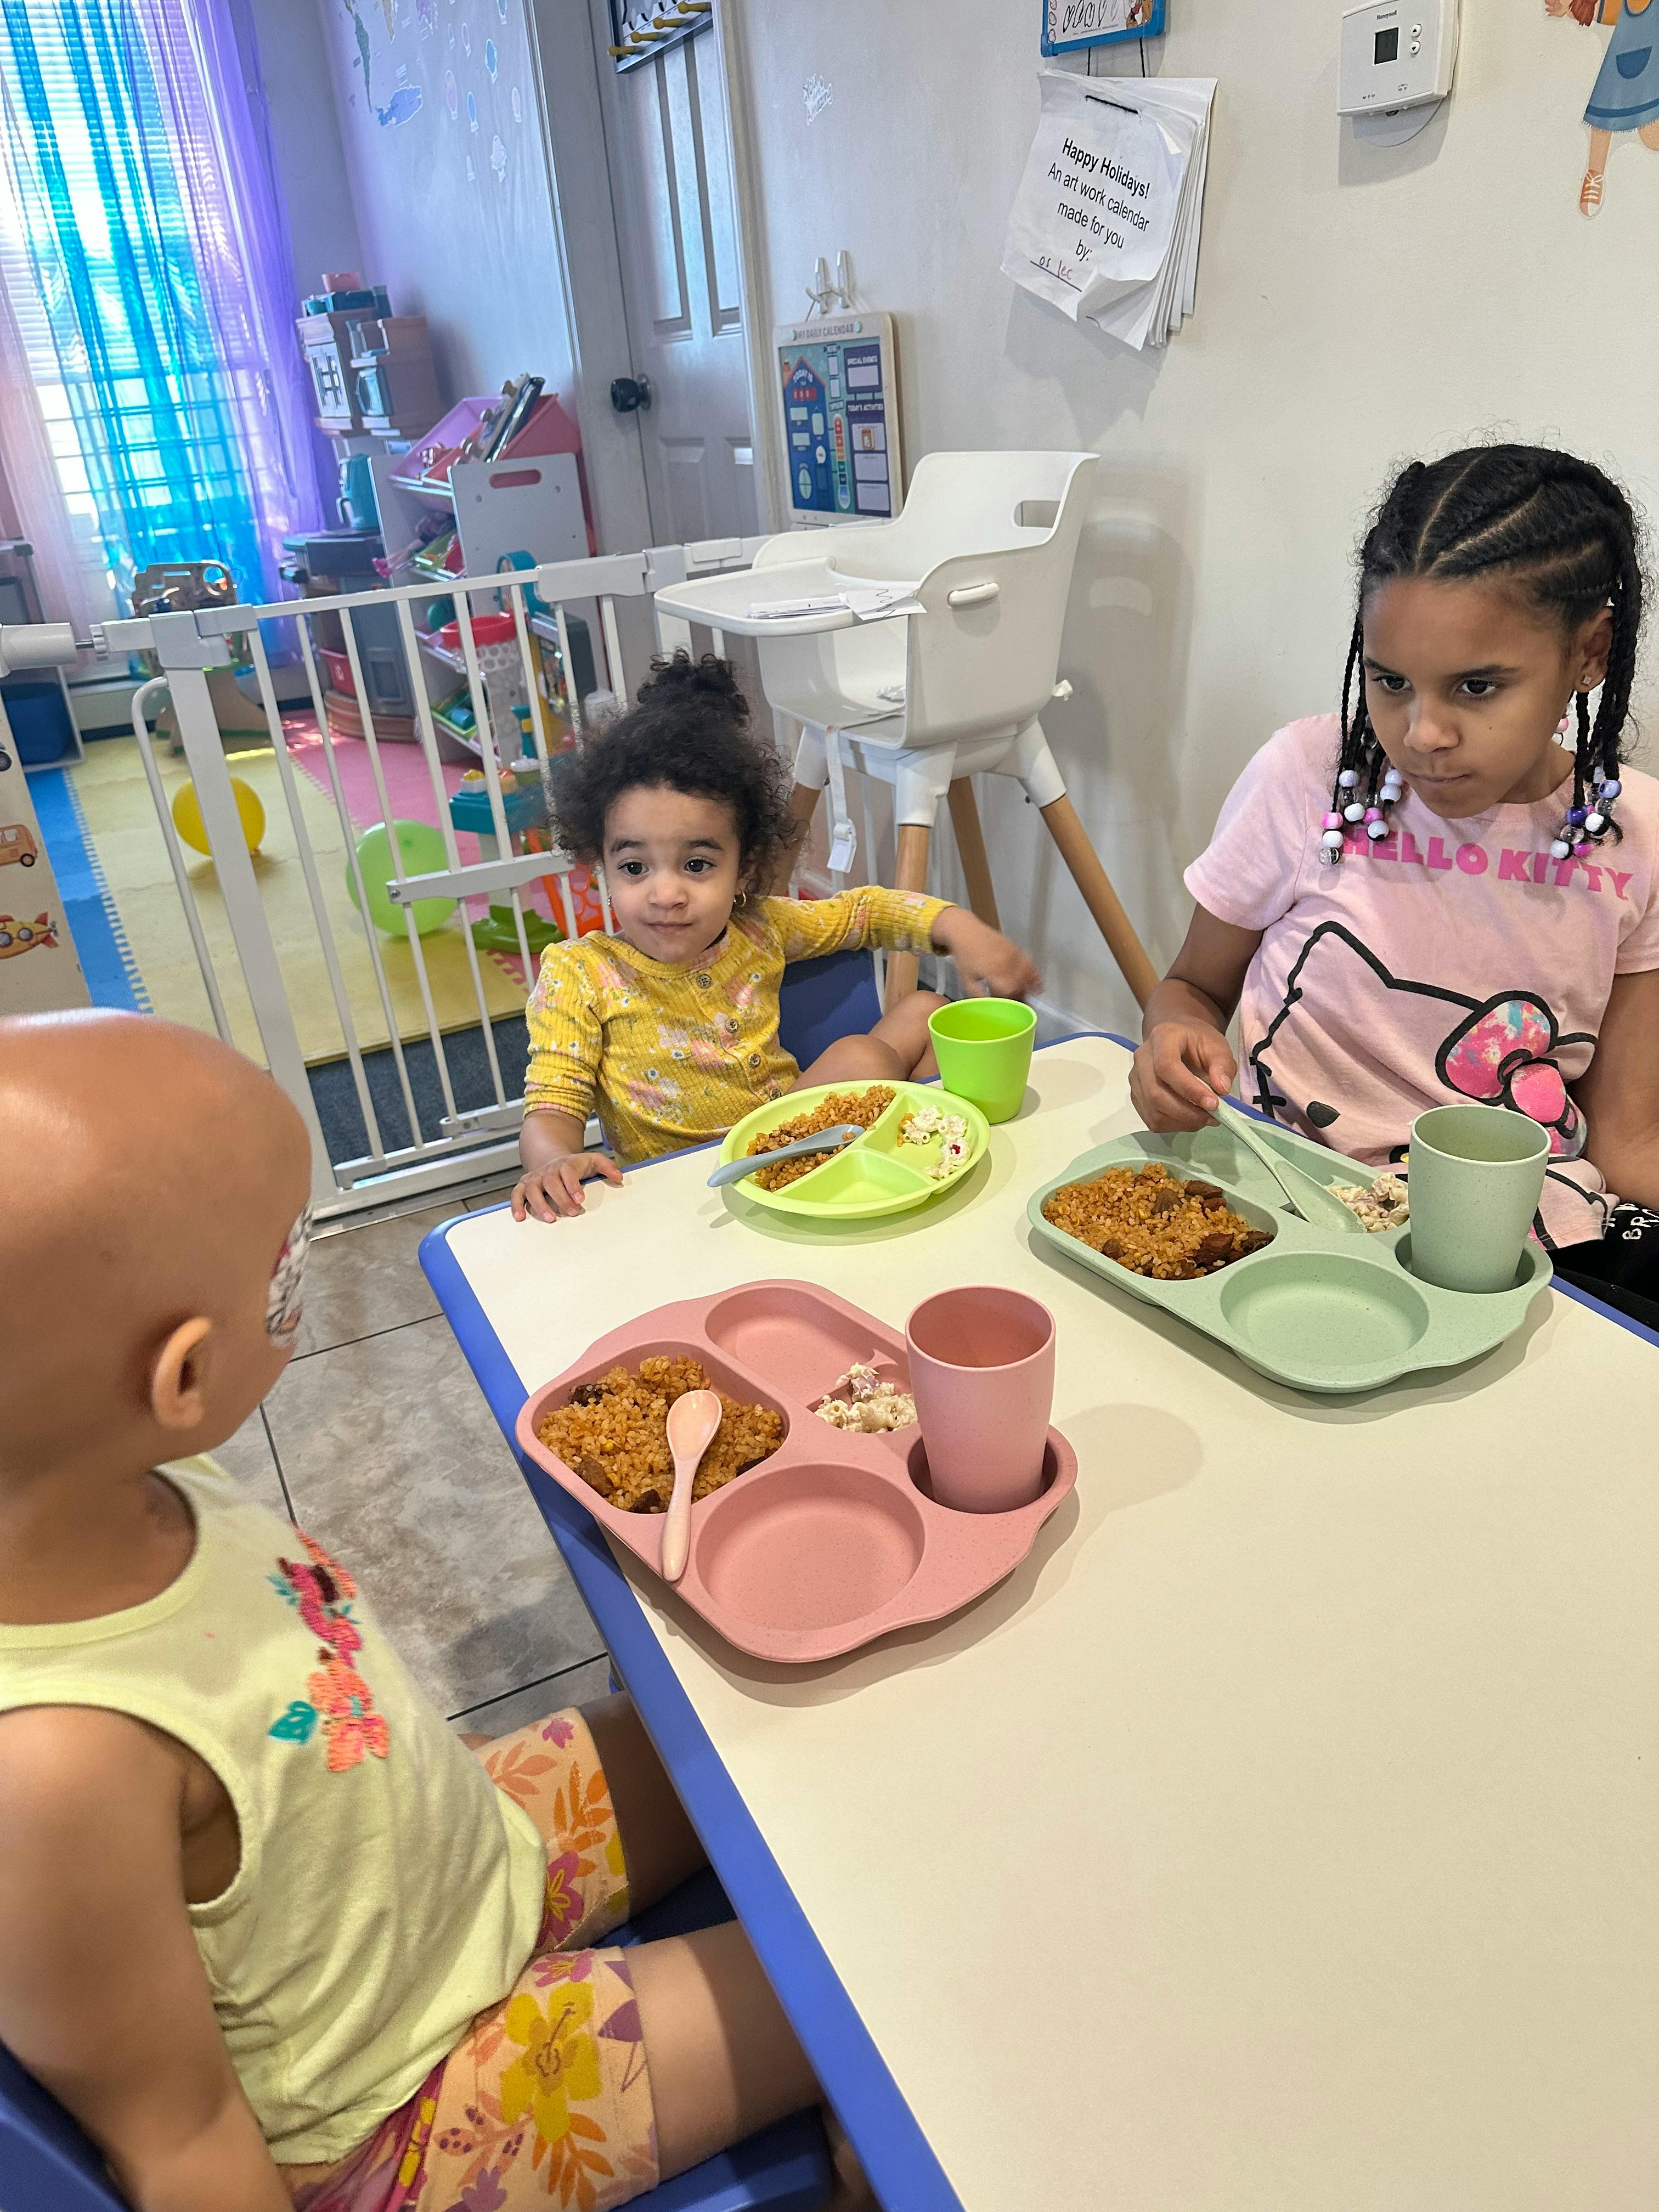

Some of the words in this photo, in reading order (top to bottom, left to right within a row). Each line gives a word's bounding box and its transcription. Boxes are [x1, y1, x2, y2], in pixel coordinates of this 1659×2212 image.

[1048, 162, 1062, 183] An
[1063, 174, 1079, 191] art
[1080, 182, 1107, 206] work
[1107, 198, 1150, 232] calendar
[1062, 137, 1099, 173] Happy
[1100, 157, 1150, 199] Holidays!
[1057, 202, 1088, 227] made
[1090, 216, 1105, 236] for
[1103, 228, 1125, 249] you
[1075, 239, 1093, 262] by:
[1342, 826, 1488, 875] HELLO
[1498, 848, 1634, 901] KITTY
